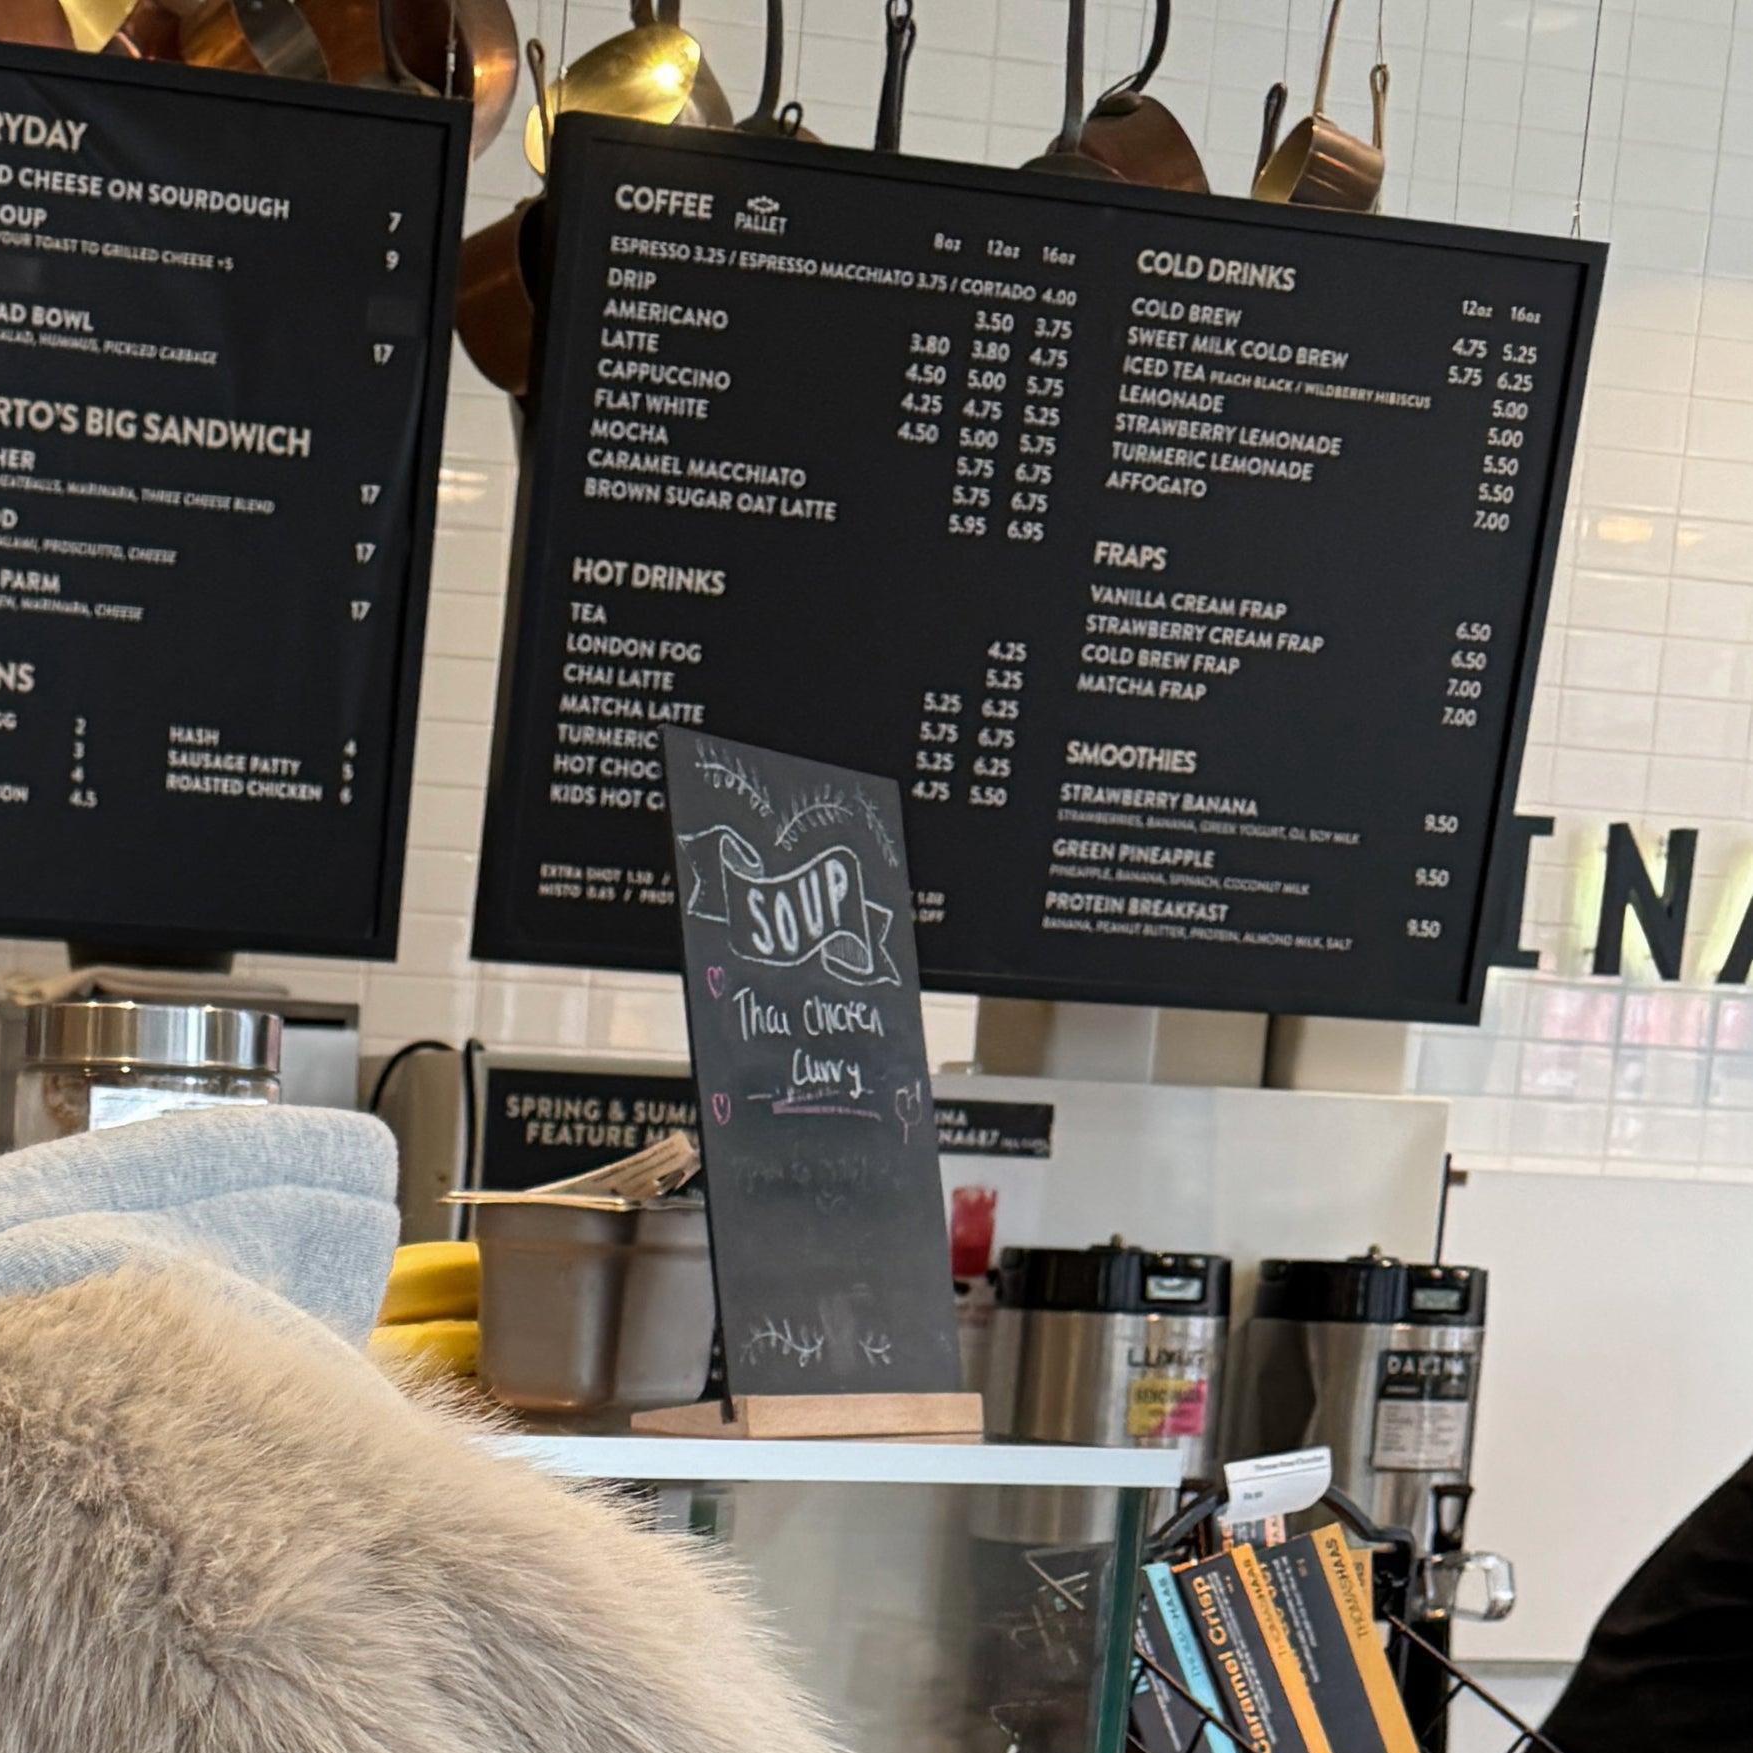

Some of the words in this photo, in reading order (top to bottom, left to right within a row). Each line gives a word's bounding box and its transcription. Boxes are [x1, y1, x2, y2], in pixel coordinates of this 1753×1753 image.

[18, 167, 103, 197] CHEESE
[107, 178, 143, 201] ON
[148, 183, 290, 219] SOURDOUGH
[388, 211, 402, 233] 7
[615, 184, 714, 219] COFFEE
[734, 211, 788, 235] PALLET
[386, 250, 400, 270] 9
[610, 235, 691, 261] ESPRESSO
[693, 245, 726, 265] 3.25
[738, 250, 818, 276] ESPRESSO
[819, 261, 915, 288] MACCHIATO
[916, 272, 948, 292] 3.75
[960, 277, 1037, 302] CORTADO
[1041, 288, 1077, 307] 4.00
[1137, 249, 1204, 279] COLD
[1207, 257, 1297, 292] DRINKS
[607, 267, 657, 290] DRIP
[974, 310, 1015, 333] 3.50
[1034, 317, 1073, 340] 3.75
[1131, 297, 1185, 321] COLD
[1188, 303, 1243, 328] BREW
[31, 305, 94, 332] BOWL
[373, 343, 394, 364] 17
[601, 328, 660, 353] LATTE
[603, 298, 729, 330] AMERICANO
[910, 332, 951, 356] 3.80
[971, 339, 1011, 362] 3.80
[1029, 347, 1068, 369] 4.75
[1127, 325, 1189, 350] SWEET
[1191, 334, 1238, 357] MILK
[1240, 340, 1293, 364] COLD
[1295, 346, 1349, 369] BREW
[597, 358, 731, 391] CAPPUCCINO
[1123, 355, 1169, 378] ICED
[1172, 360, 1212, 382] TEA
[594, 387, 642, 411] FLAT
[645, 393, 710, 419] WHITE
[1118, 384, 1225, 414] LEMONADE
[85, 406, 137, 440] BIG
[143, 412, 311, 457] SANDWICH
[590, 419, 669, 445] MOCHA
[1115, 412, 1238, 443] STRAWBERRY
[1238, 426, 1343, 456] LEMONADE
[587, 448, 683, 476] CARAMEL
[686, 459, 807, 489] MACCHIATO
[360, 484, 381, 504] 17
[584, 477, 661, 503] BROWN
[665, 485, 733, 511] SUGAR
[736, 492, 777, 514] OAT
[780, 497, 837, 521] LATTE
[1105, 470, 1207, 498] AFFOGATO
[1473, 510, 1510, 532] 7.00
[355, 542, 376, 563] 17
[1093, 540, 1167, 571] FRAPS
[0, 568, 61, 593] PARM
[351, 600, 371, 621] 17
[572, 558, 629, 586] HOT
[631, 562, 726, 595] DRINKS
[570, 602, 607, 624] TEA
[1090, 584, 1167, 609] VANILLA
[1170, 592, 1236, 616] CREAM
[1238, 599, 1287, 621] FRAP
[566, 632, 656, 658] LONDON
[659, 640, 702, 663] FOG
[1086, 614, 1207, 642] STRAWBERRY
[1208, 626, 1273, 649] CREAM
[1276, 632, 1325, 654] FRAP
[563, 663, 614, 685] CHAI
[617, 668, 675, 691] LATTE
[1077, 673, 1155, 697] MATCHA
[1158, 680, 1207, 701] FRAP
[1066, 740, 1197, 774] SMOOTHIES
[1060, 782, 1181, 810] STRAWBERRY
[1181, 792, 1258, 817] BANANA
[1424, 814, 1459, 834] 9.50
[1052, 838, 1116, 861] GREEN
[1118, 843, 1216, 869] PINEAPPLE
[1415, 867, 1450, 887] 9.50
[747, 858, 849, 957] SOUP
[1045, 890, 1125, 914] PROTEIN
[1127, 897, 1229, 922] BREAKFAST
[1406, 918, 1441, 939] 9.50
[731, 986, 792, 1042] Thai
[791, 1047, 863, 1099] Curry
[505, 1093, 602, 1121] SPRING
[607, 1099, 626, 1122] &
[524, 1120, 638, 1149] FEATURE
[1191, 1575, 1228, 1647] Crisp
